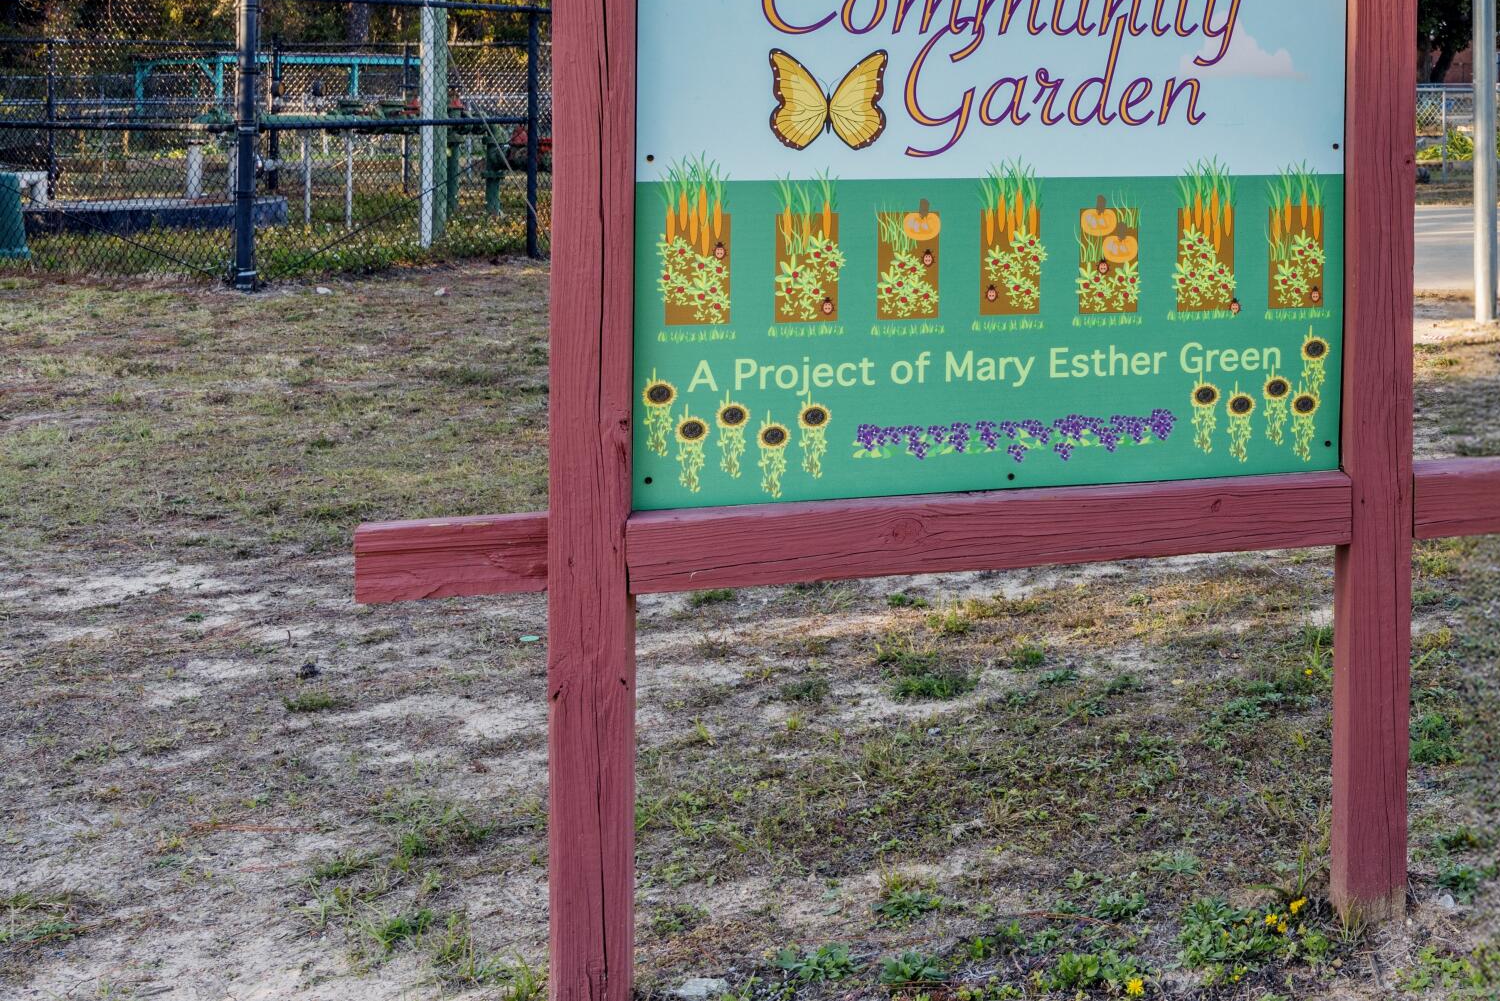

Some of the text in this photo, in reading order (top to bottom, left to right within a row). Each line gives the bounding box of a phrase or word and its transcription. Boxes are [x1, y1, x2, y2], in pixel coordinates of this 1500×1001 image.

[904, 13, 1207, 158] Garden
[687, 341, 1281, 396] A Project of Mary Esther Green
